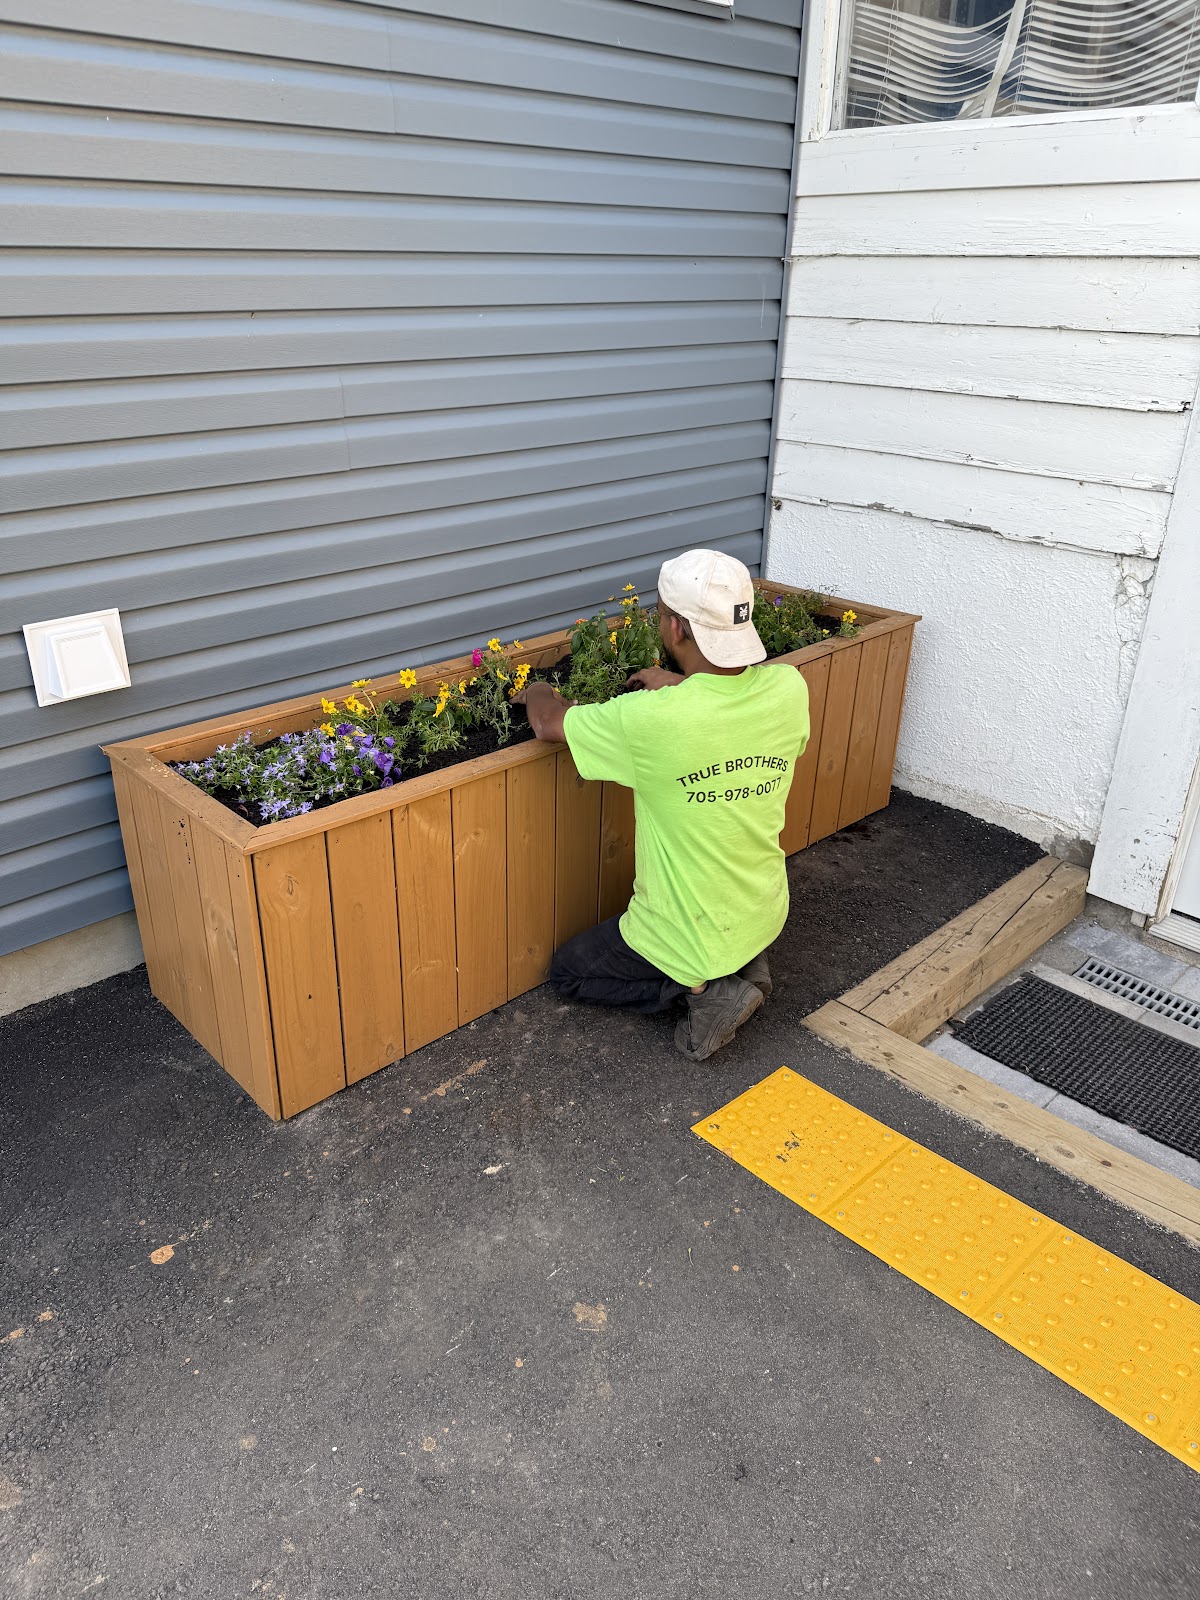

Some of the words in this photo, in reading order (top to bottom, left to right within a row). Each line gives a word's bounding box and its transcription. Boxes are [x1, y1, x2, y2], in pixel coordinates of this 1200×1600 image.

[676, 763, 721, 787] TRUE
[725, 756, 789, 772] BROTHERS
[686, 777, 782, 803] 705-978-0077
